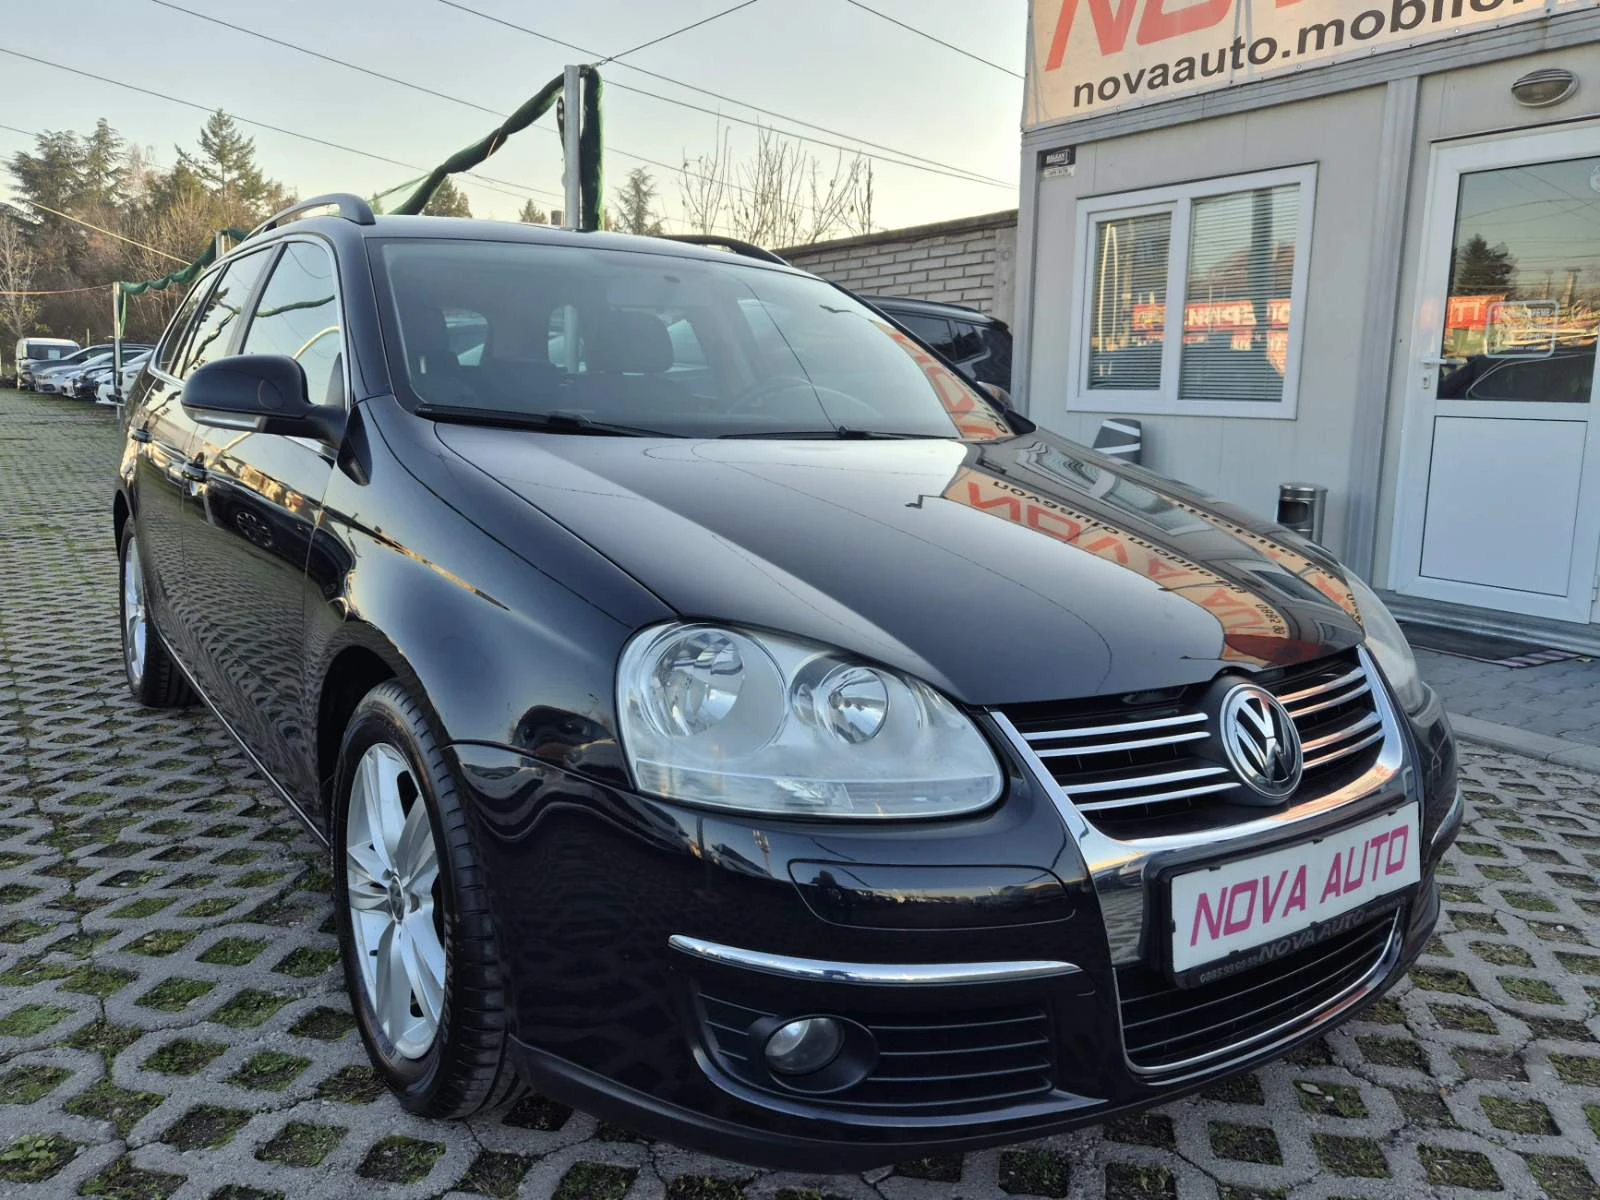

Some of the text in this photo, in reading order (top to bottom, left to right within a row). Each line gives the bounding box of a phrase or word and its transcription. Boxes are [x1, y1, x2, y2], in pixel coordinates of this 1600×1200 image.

[1190, 825, 1408, 946] NOVA AUTO
[1257, 931, 1315, 961] NOVA
[1317, 909, 1365, 940] AUTO
